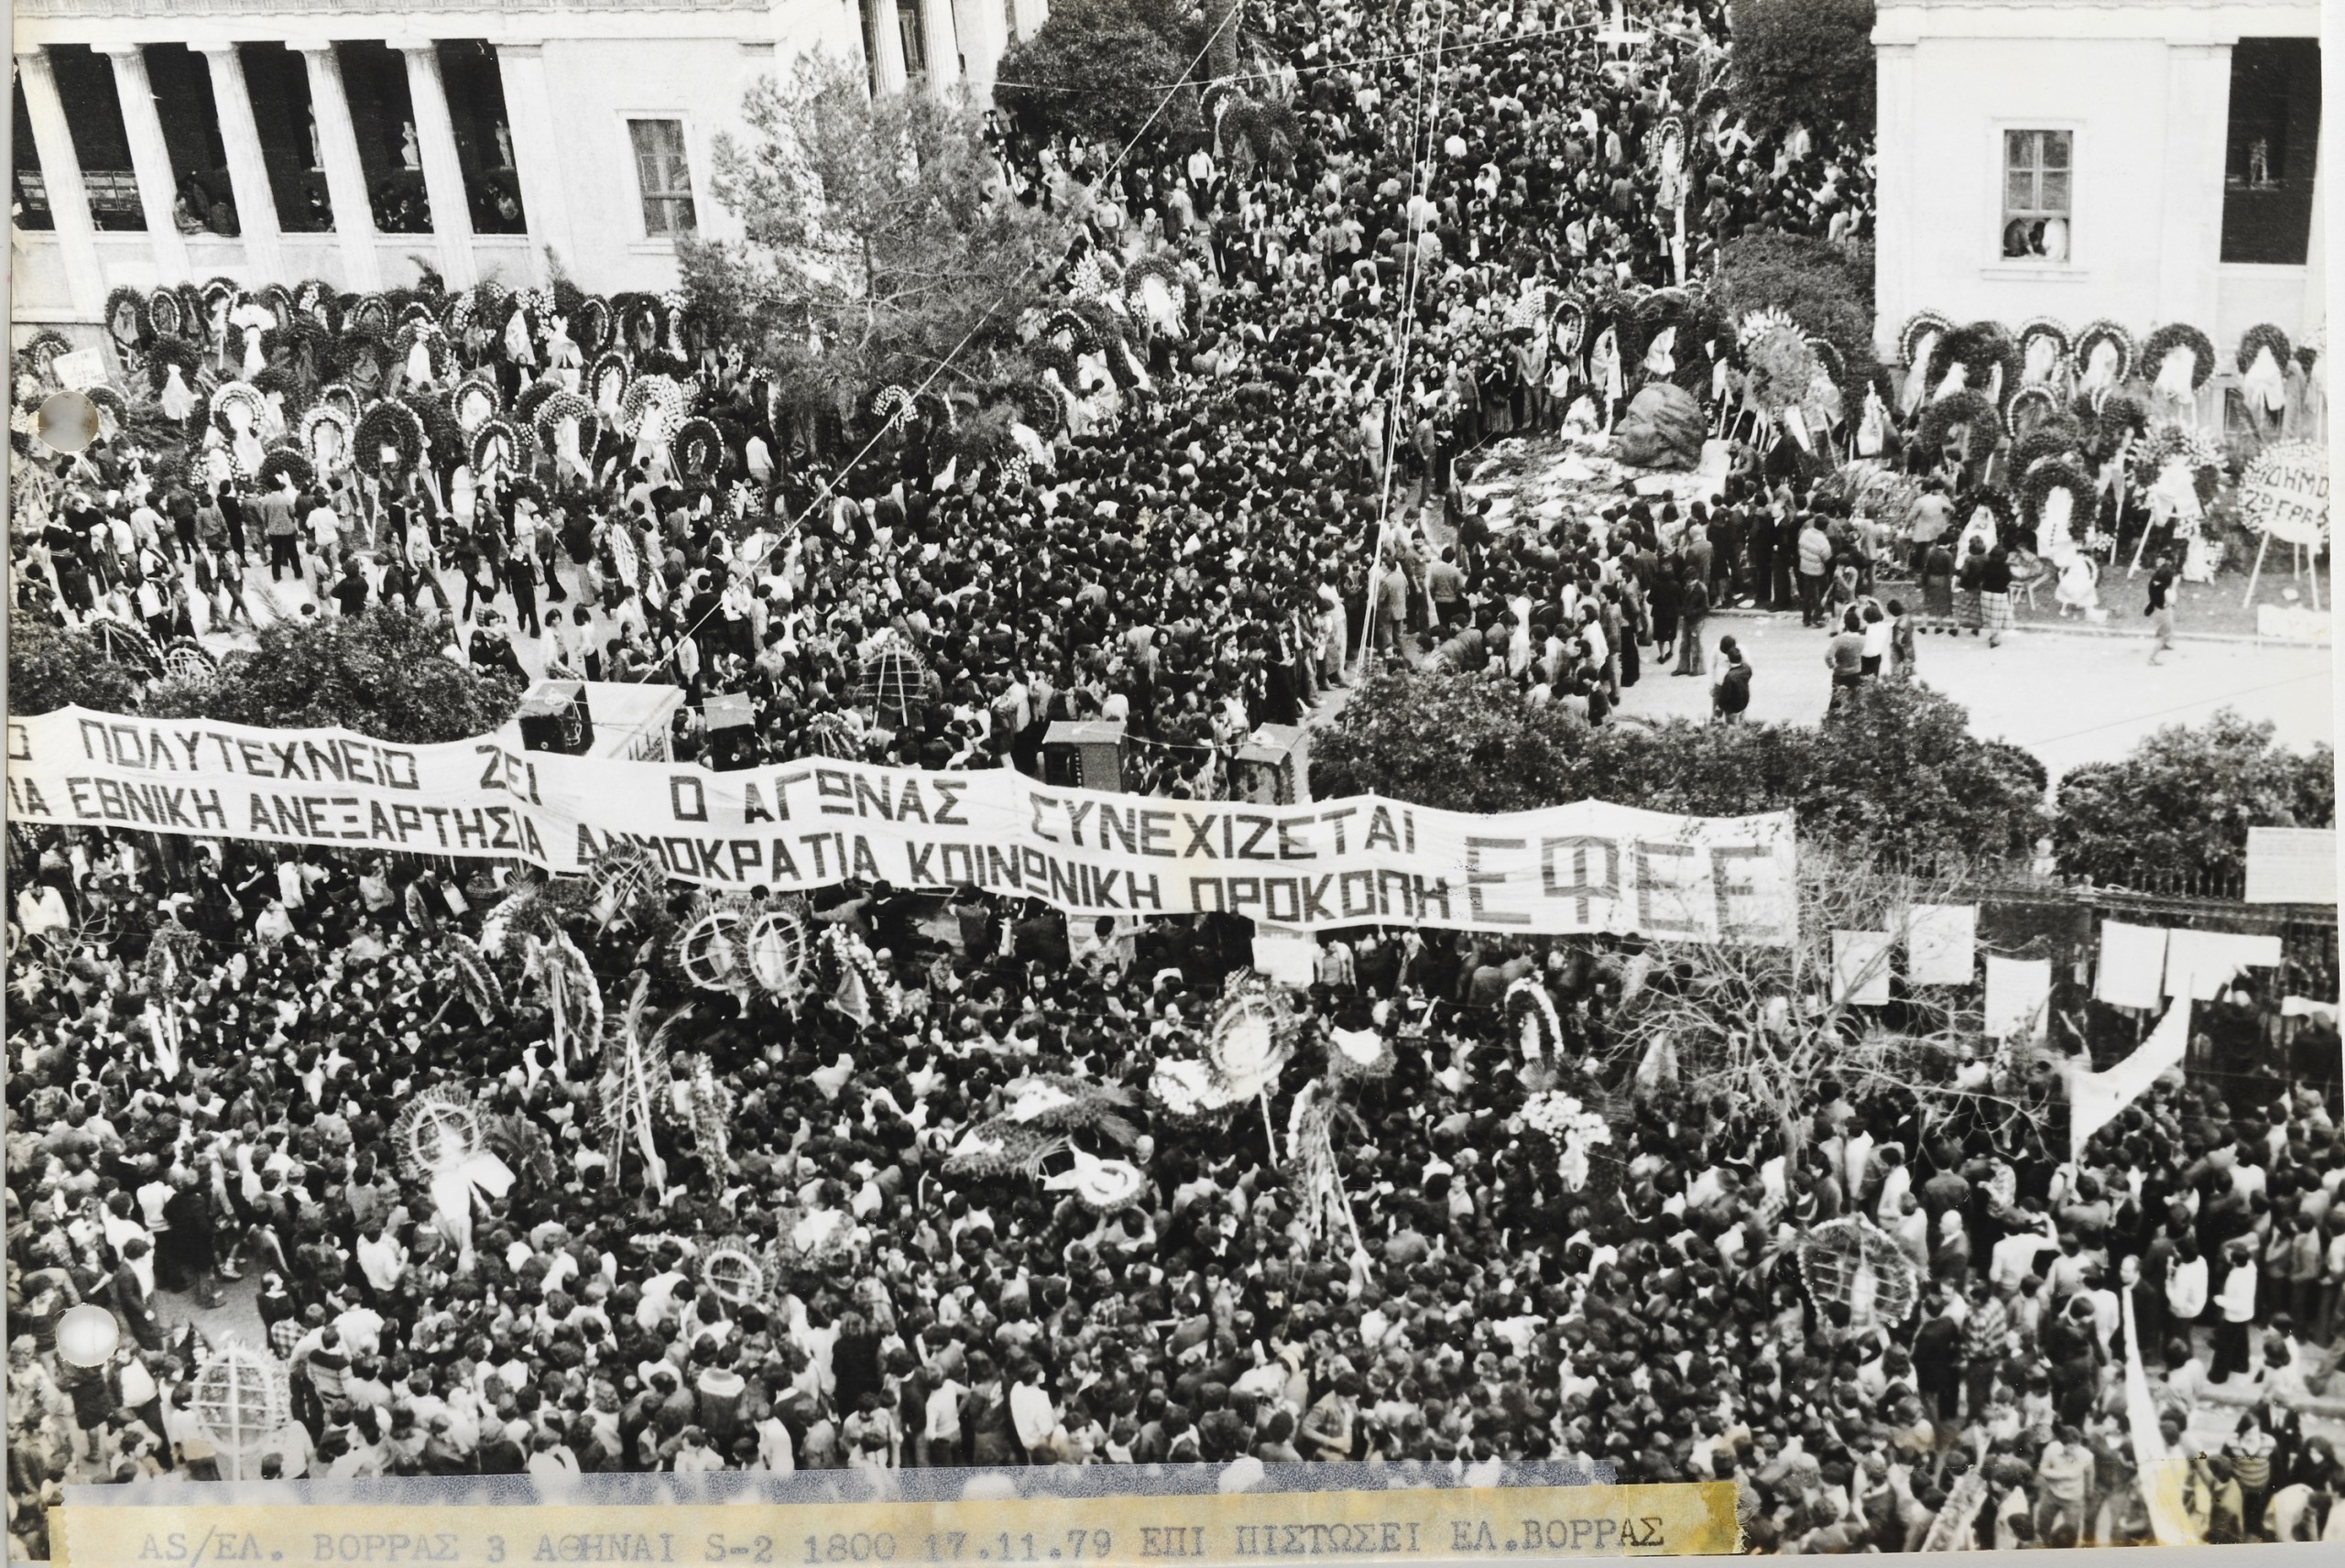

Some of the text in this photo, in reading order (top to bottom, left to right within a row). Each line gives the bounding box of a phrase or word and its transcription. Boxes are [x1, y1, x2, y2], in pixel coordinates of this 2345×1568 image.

[66, 778, 228, 830] ΕΘΝΙΚΗ
[250, 793, 548, 862] ΑΝΕΞΑΡΤΗΣΙΑ
[906, 841, 1162, 909] ΚΟΙΝΩΝΙΚΗ
[1190, 869, 1450, 922] ΠΡΟΚΟΠΗ
[78, 718, 420, 789] ΠΟΛΥΤΕΧΝΕΙΟ
[476, 745, 541, 806] ΖΕΙ
[670, 775, 708, 822] Ο
[745, 768, 968, 825] ΑΓΩΝΑΣ
[1030, 791, 1415, 860] ΣΥΝΕΧΙΖΕΤΑΙ
[1466, 835, 1781, 938] ΕΦΕΕ
